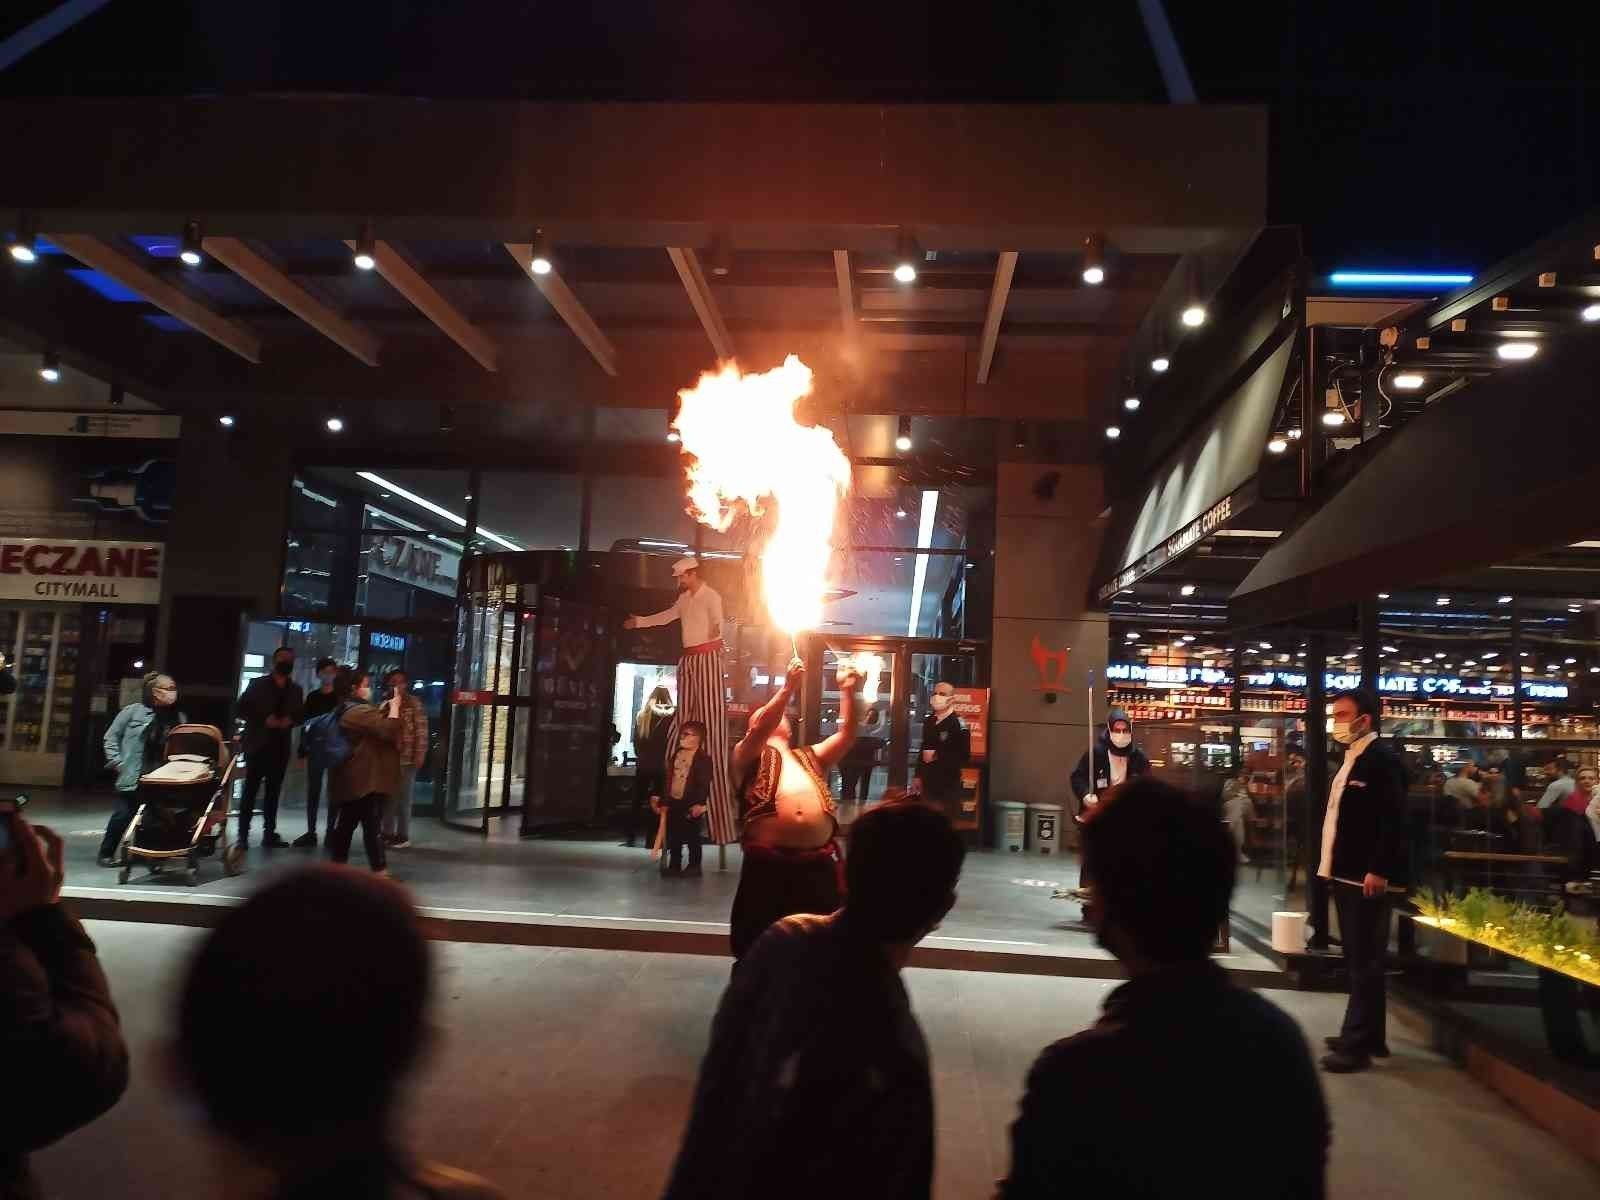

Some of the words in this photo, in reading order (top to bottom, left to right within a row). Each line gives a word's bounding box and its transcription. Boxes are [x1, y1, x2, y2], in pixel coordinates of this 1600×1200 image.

[1202, 496, 1232, 531] COFFEE
[0, 544, 159, 578] ECZANE
[35, 581, 119, 598] CITYMALL
